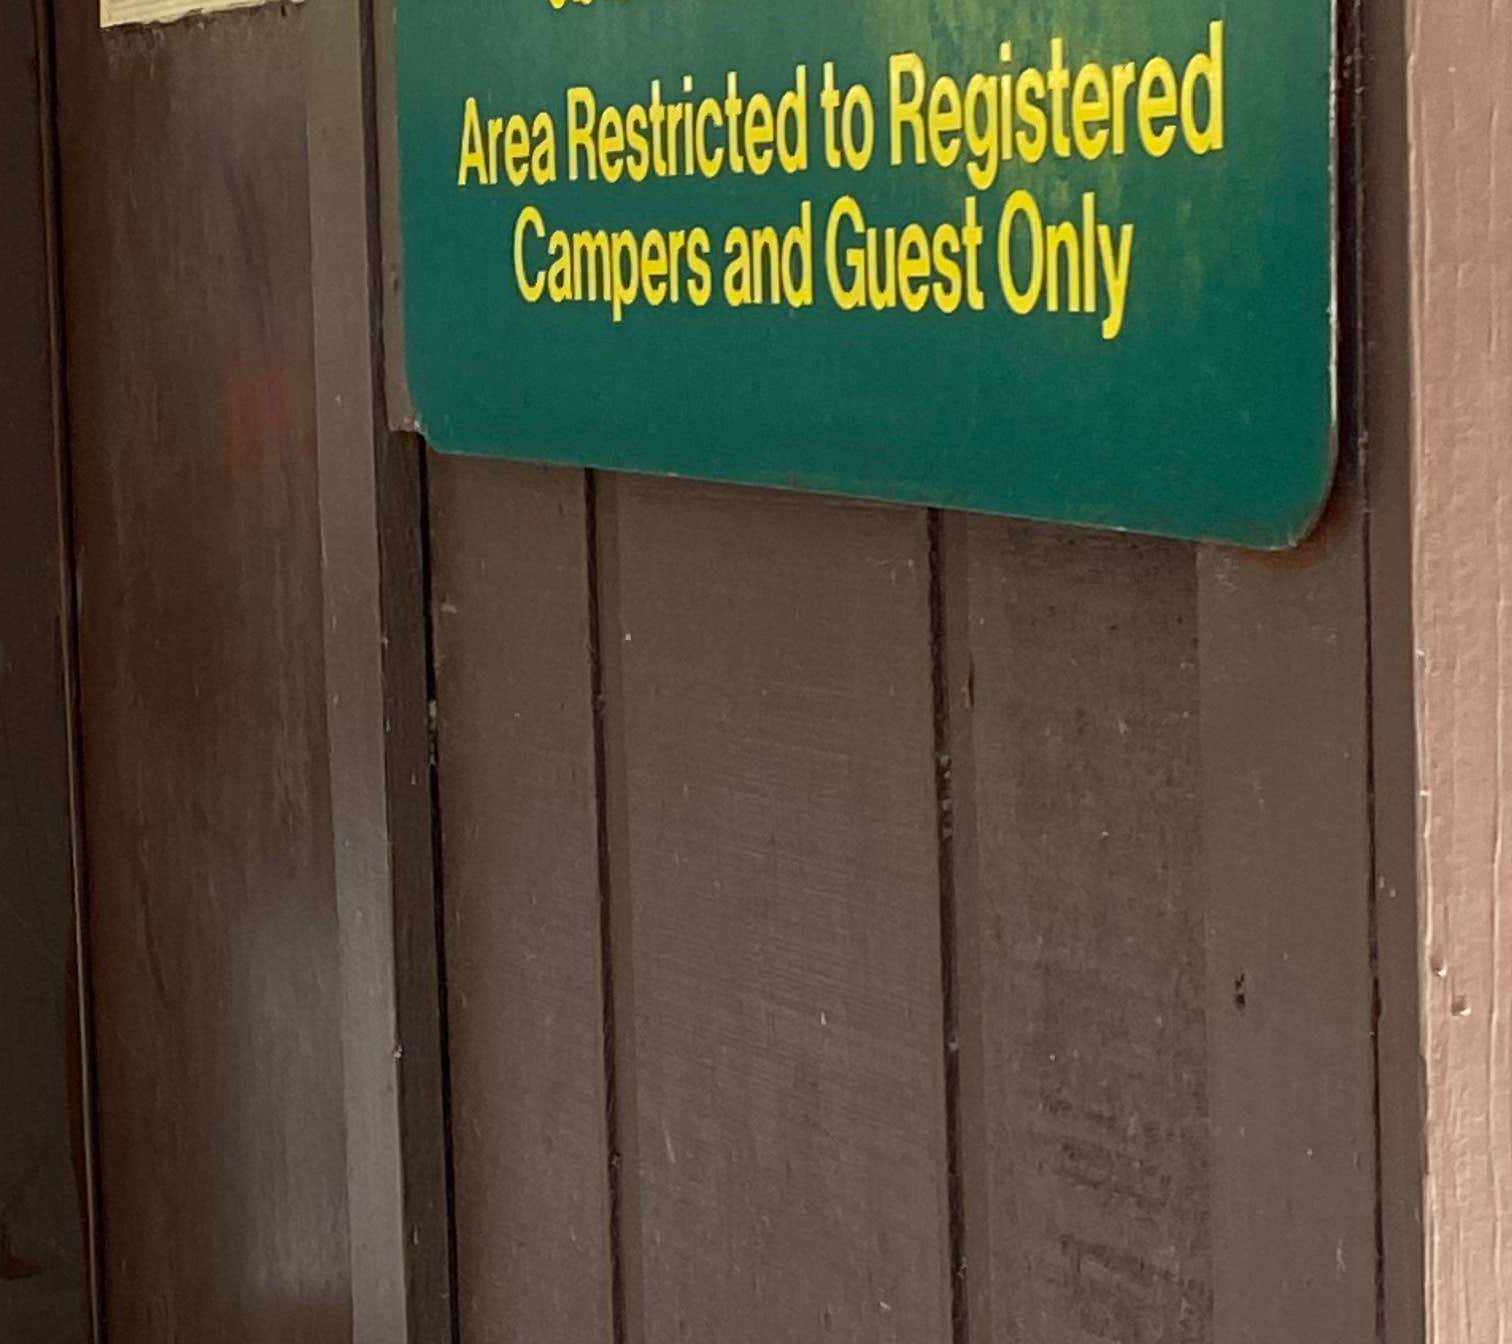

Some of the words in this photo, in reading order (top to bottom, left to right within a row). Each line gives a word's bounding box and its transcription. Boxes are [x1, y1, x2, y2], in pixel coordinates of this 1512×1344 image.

[457, 96, 557, 186] Area
[567, 65, 809, 183] Restricted
[820, 62, 874, 171] to
[889, 20, 1225, 190] Registered
[513, 205, 712, 322] Campers
[723, 201, 813, 308] and
[824, 194, 985, 313] Guest
[996, 188, 1135, 340] Only
